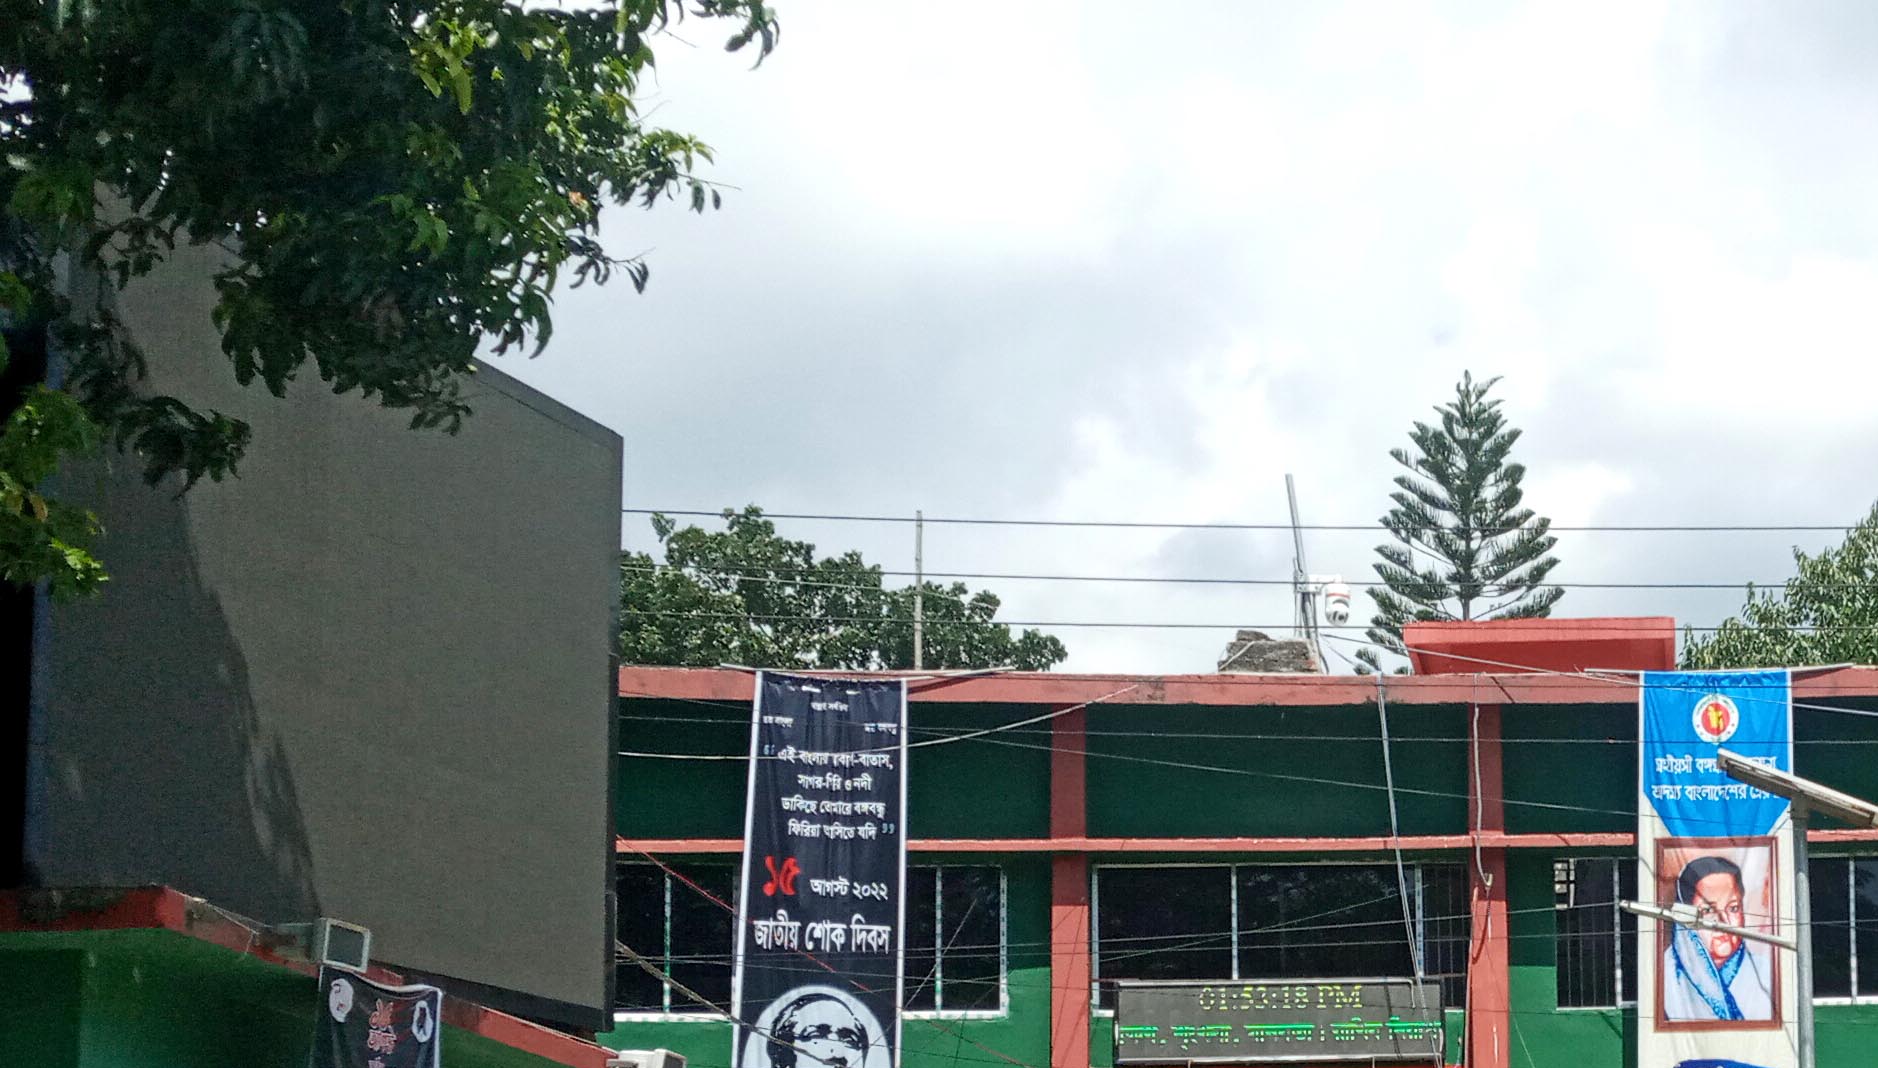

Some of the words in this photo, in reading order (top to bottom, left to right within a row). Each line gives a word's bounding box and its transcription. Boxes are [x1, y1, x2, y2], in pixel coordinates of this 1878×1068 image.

[853, 773, 873, 791] নদী
[1685, 784, 1748, 801] বাংলাদেশের
[781, 795, 818, 815] ডাকিছে
[854, 802, 887, 819] বঙ্গবন্ধু
[788, 819, 820, 838] ফিরিয়া
[857, 823, 877, 840] যদি
[763, 855, 801, 896] ১৫
[810, 876, 850, 897] আগস্ট
[852, 881, 889, 901] ২০২২
[753, 909, 801, 951] জাতীয়
[805, 920, 847, 953] শোক
[850, 913, 892, 955] দিবস
